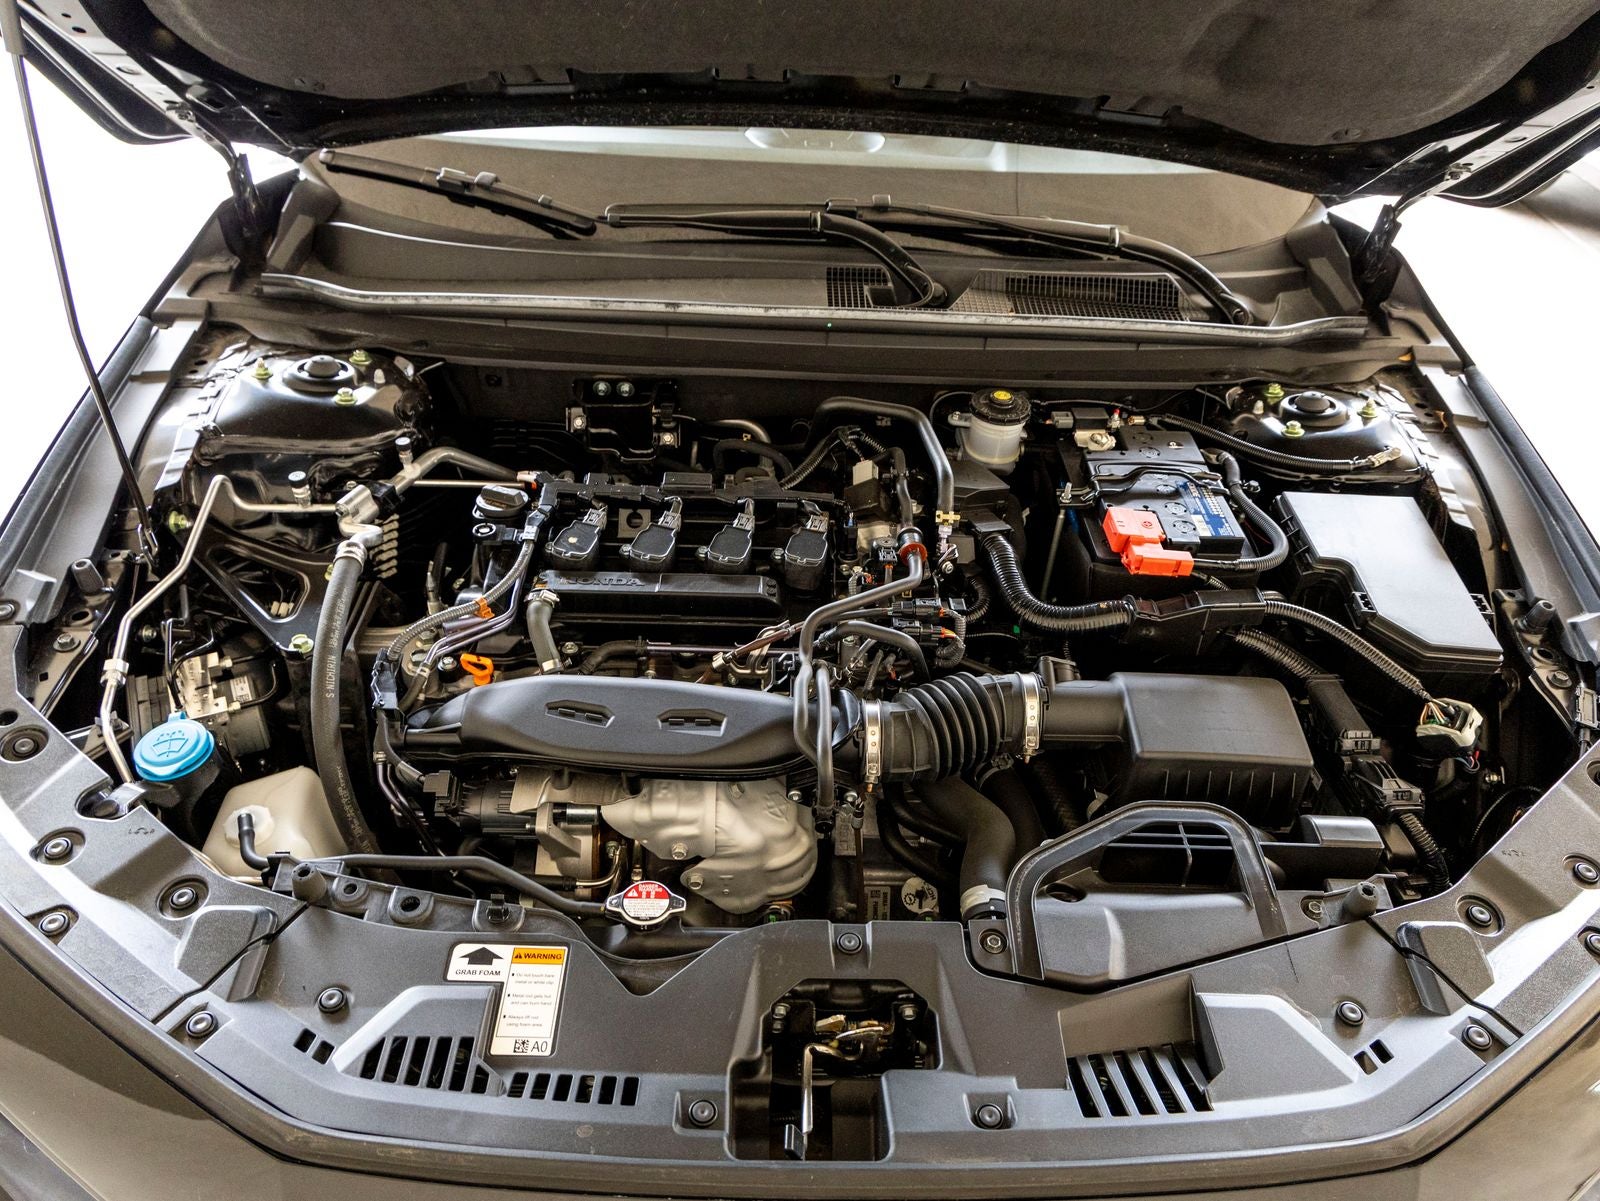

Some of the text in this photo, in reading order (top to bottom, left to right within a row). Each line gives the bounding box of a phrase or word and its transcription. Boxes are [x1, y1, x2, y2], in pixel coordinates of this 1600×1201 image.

[325, 655, 337, 698] S-NICHIRIN
[523, 952, 562, 960] WARNING
[455, 968, 477, 976] GRAB
[530, 1040, 548, 1053] A0
